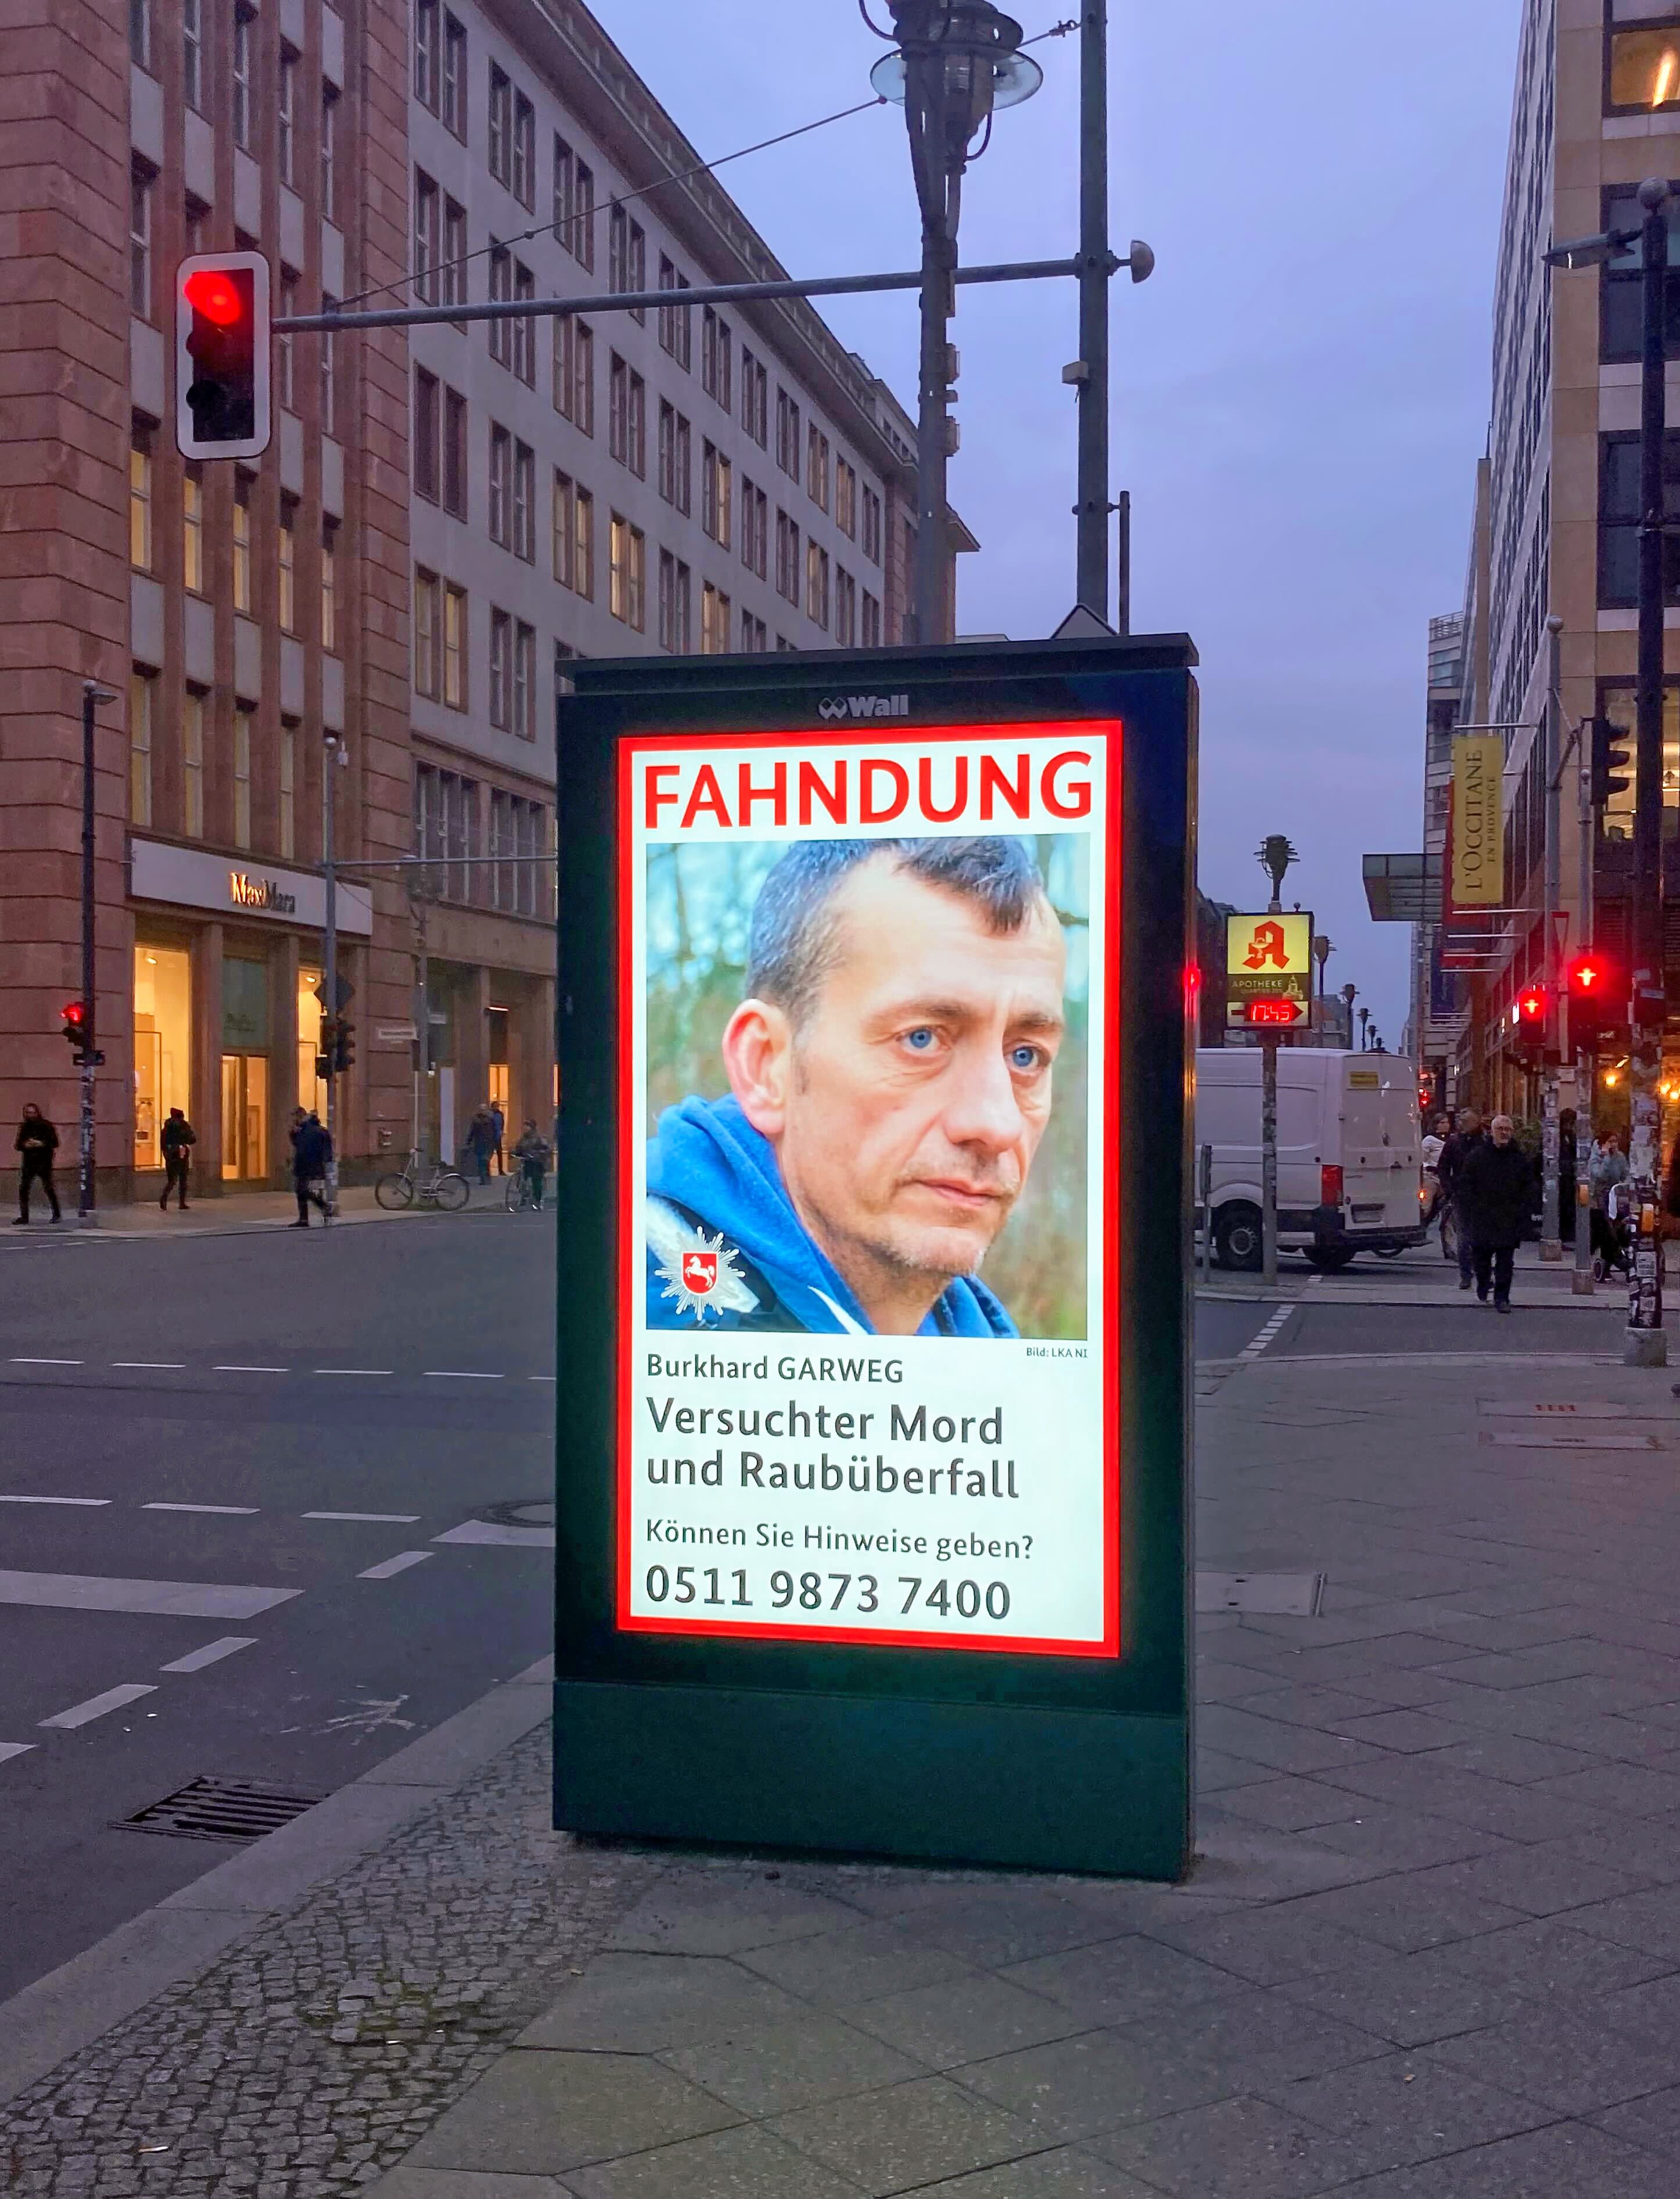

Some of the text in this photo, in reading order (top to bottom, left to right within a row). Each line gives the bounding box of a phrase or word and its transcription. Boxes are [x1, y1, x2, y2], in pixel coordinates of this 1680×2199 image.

[847, 694, 909, 717] Wall
[645, 751, 1092, 829] FAHNDUNG
[1460, 749, 1483, 890] L'OCCITANE
[1486, 776, 1496, 863] EN PROVENCE
[1232, 980, 1283, 988] APOTHEKE
[648, 1354, 903, 1383] Burkhard GARWEG
[1026, 1347, 1088, 1358] Bild: LKA NI
[646, 1397, 1002, 1444] Versuchter Mord
[648, 1449, 1020, 1498] und Raubüberfall
[647, 1519, 1033, 1562] Können Sie Hinweise geben?
[646, 1565, 1010, 1620] 0511 9873 7400
